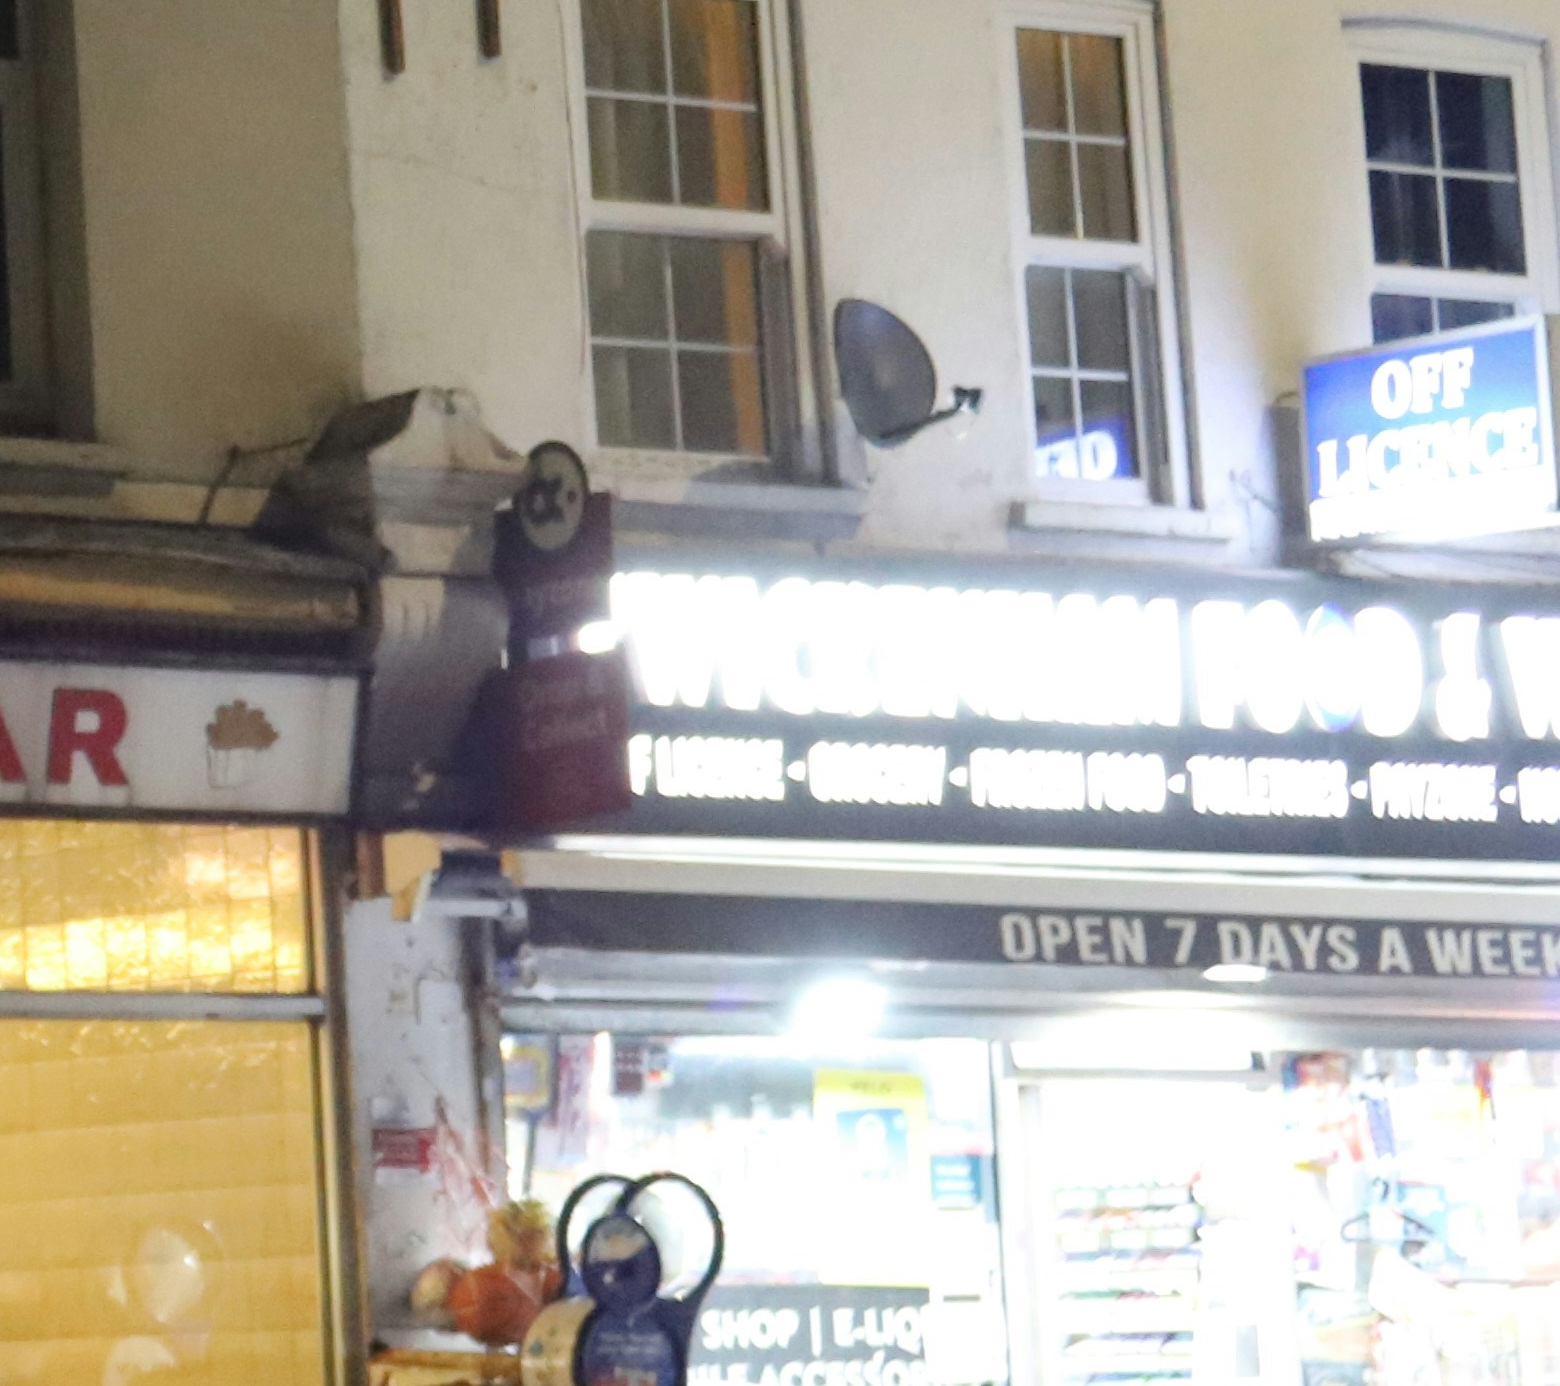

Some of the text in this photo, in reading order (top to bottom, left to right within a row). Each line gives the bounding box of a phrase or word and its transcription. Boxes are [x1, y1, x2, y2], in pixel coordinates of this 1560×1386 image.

[1371, 347, 1473, 419] OFF
[1317, 406, 1539, 498] LICENCE
[1192, 599, 1422, 737] FOOD
[999, 912, 1148, 966] OPEN
[1164, 918, 1197, 967] 7
[1217, 921, 1359, 973] DAYS
[1377, 925, 1412, 975] A
[700, 1308, 800, 1350] SHOP
